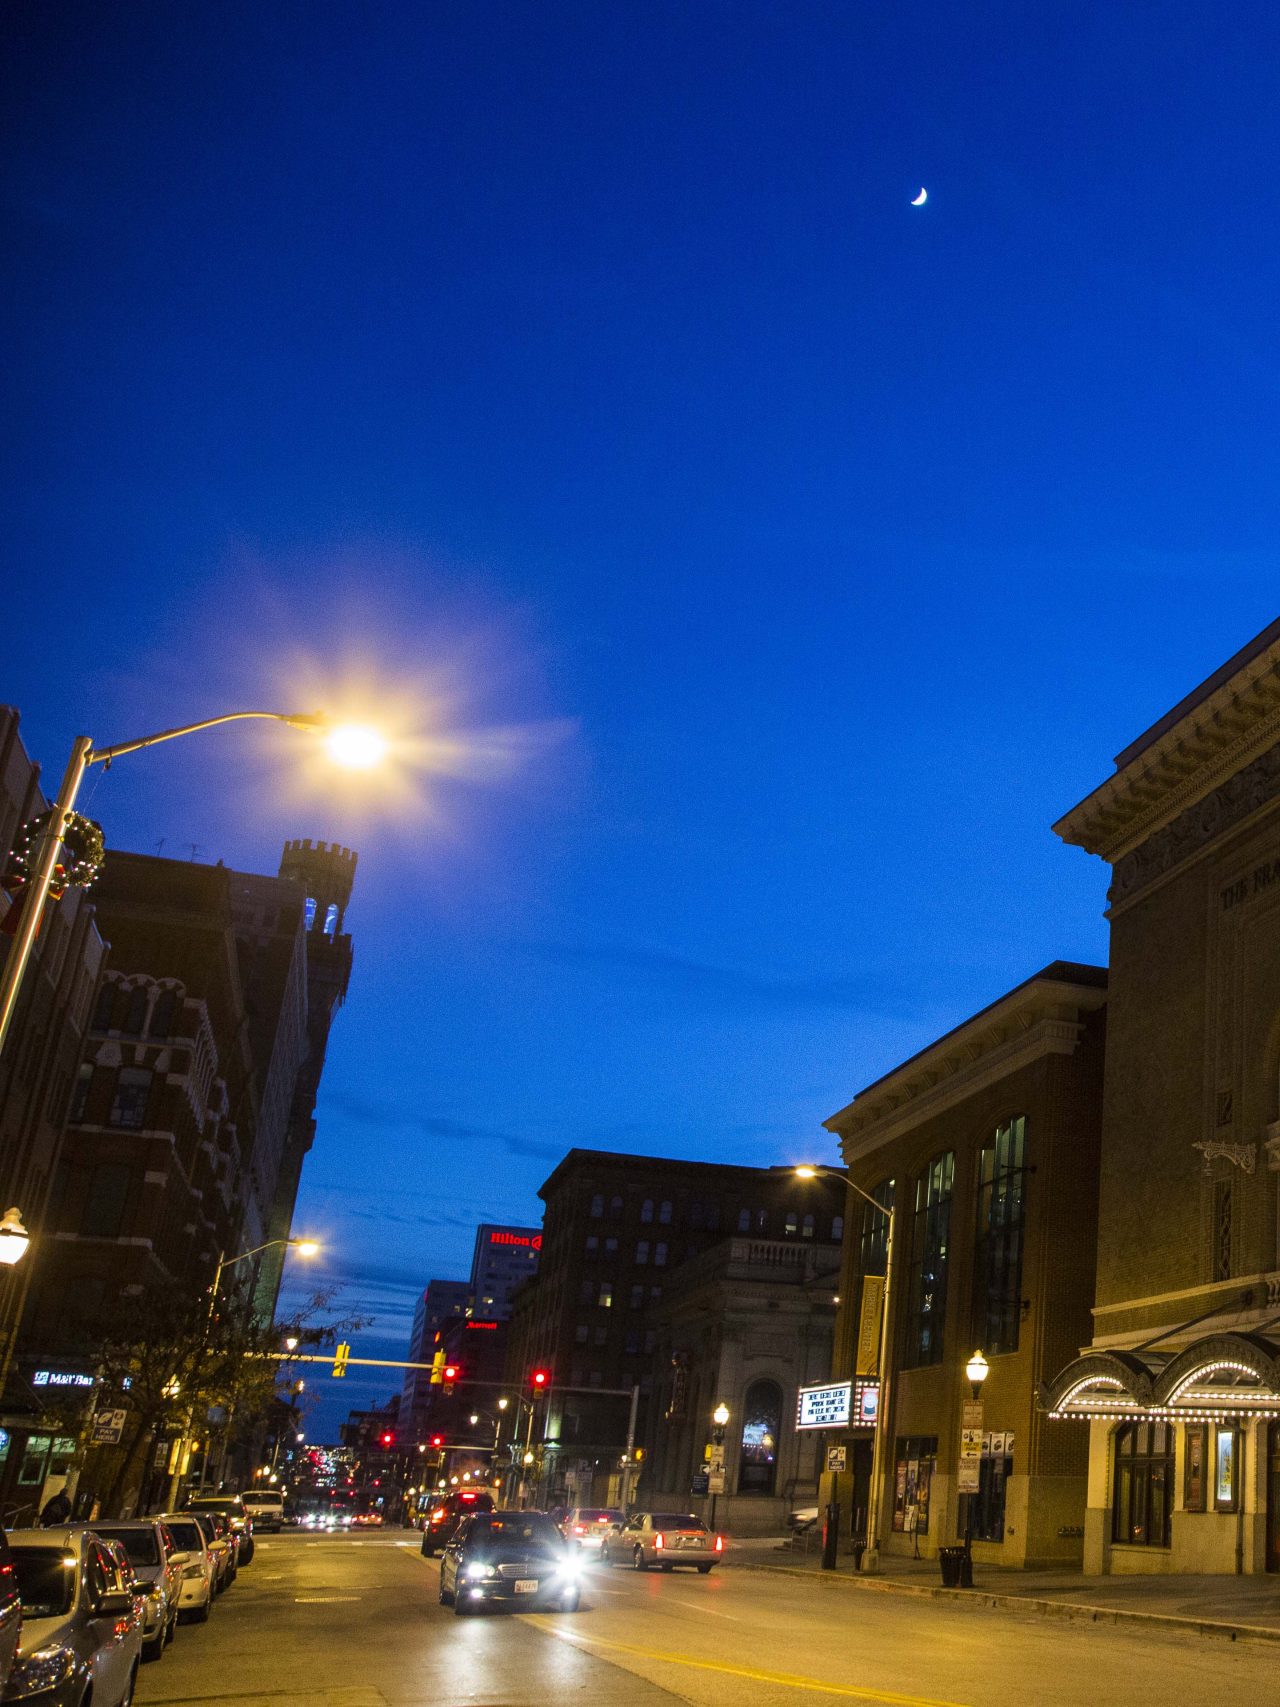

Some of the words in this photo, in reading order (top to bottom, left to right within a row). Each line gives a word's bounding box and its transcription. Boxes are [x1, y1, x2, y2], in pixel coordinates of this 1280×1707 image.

[1219, 880, 1248, 910] THE
[491, 1232, 530, 1246] Hilton
[49, 1374, 75, 1385] M&T
